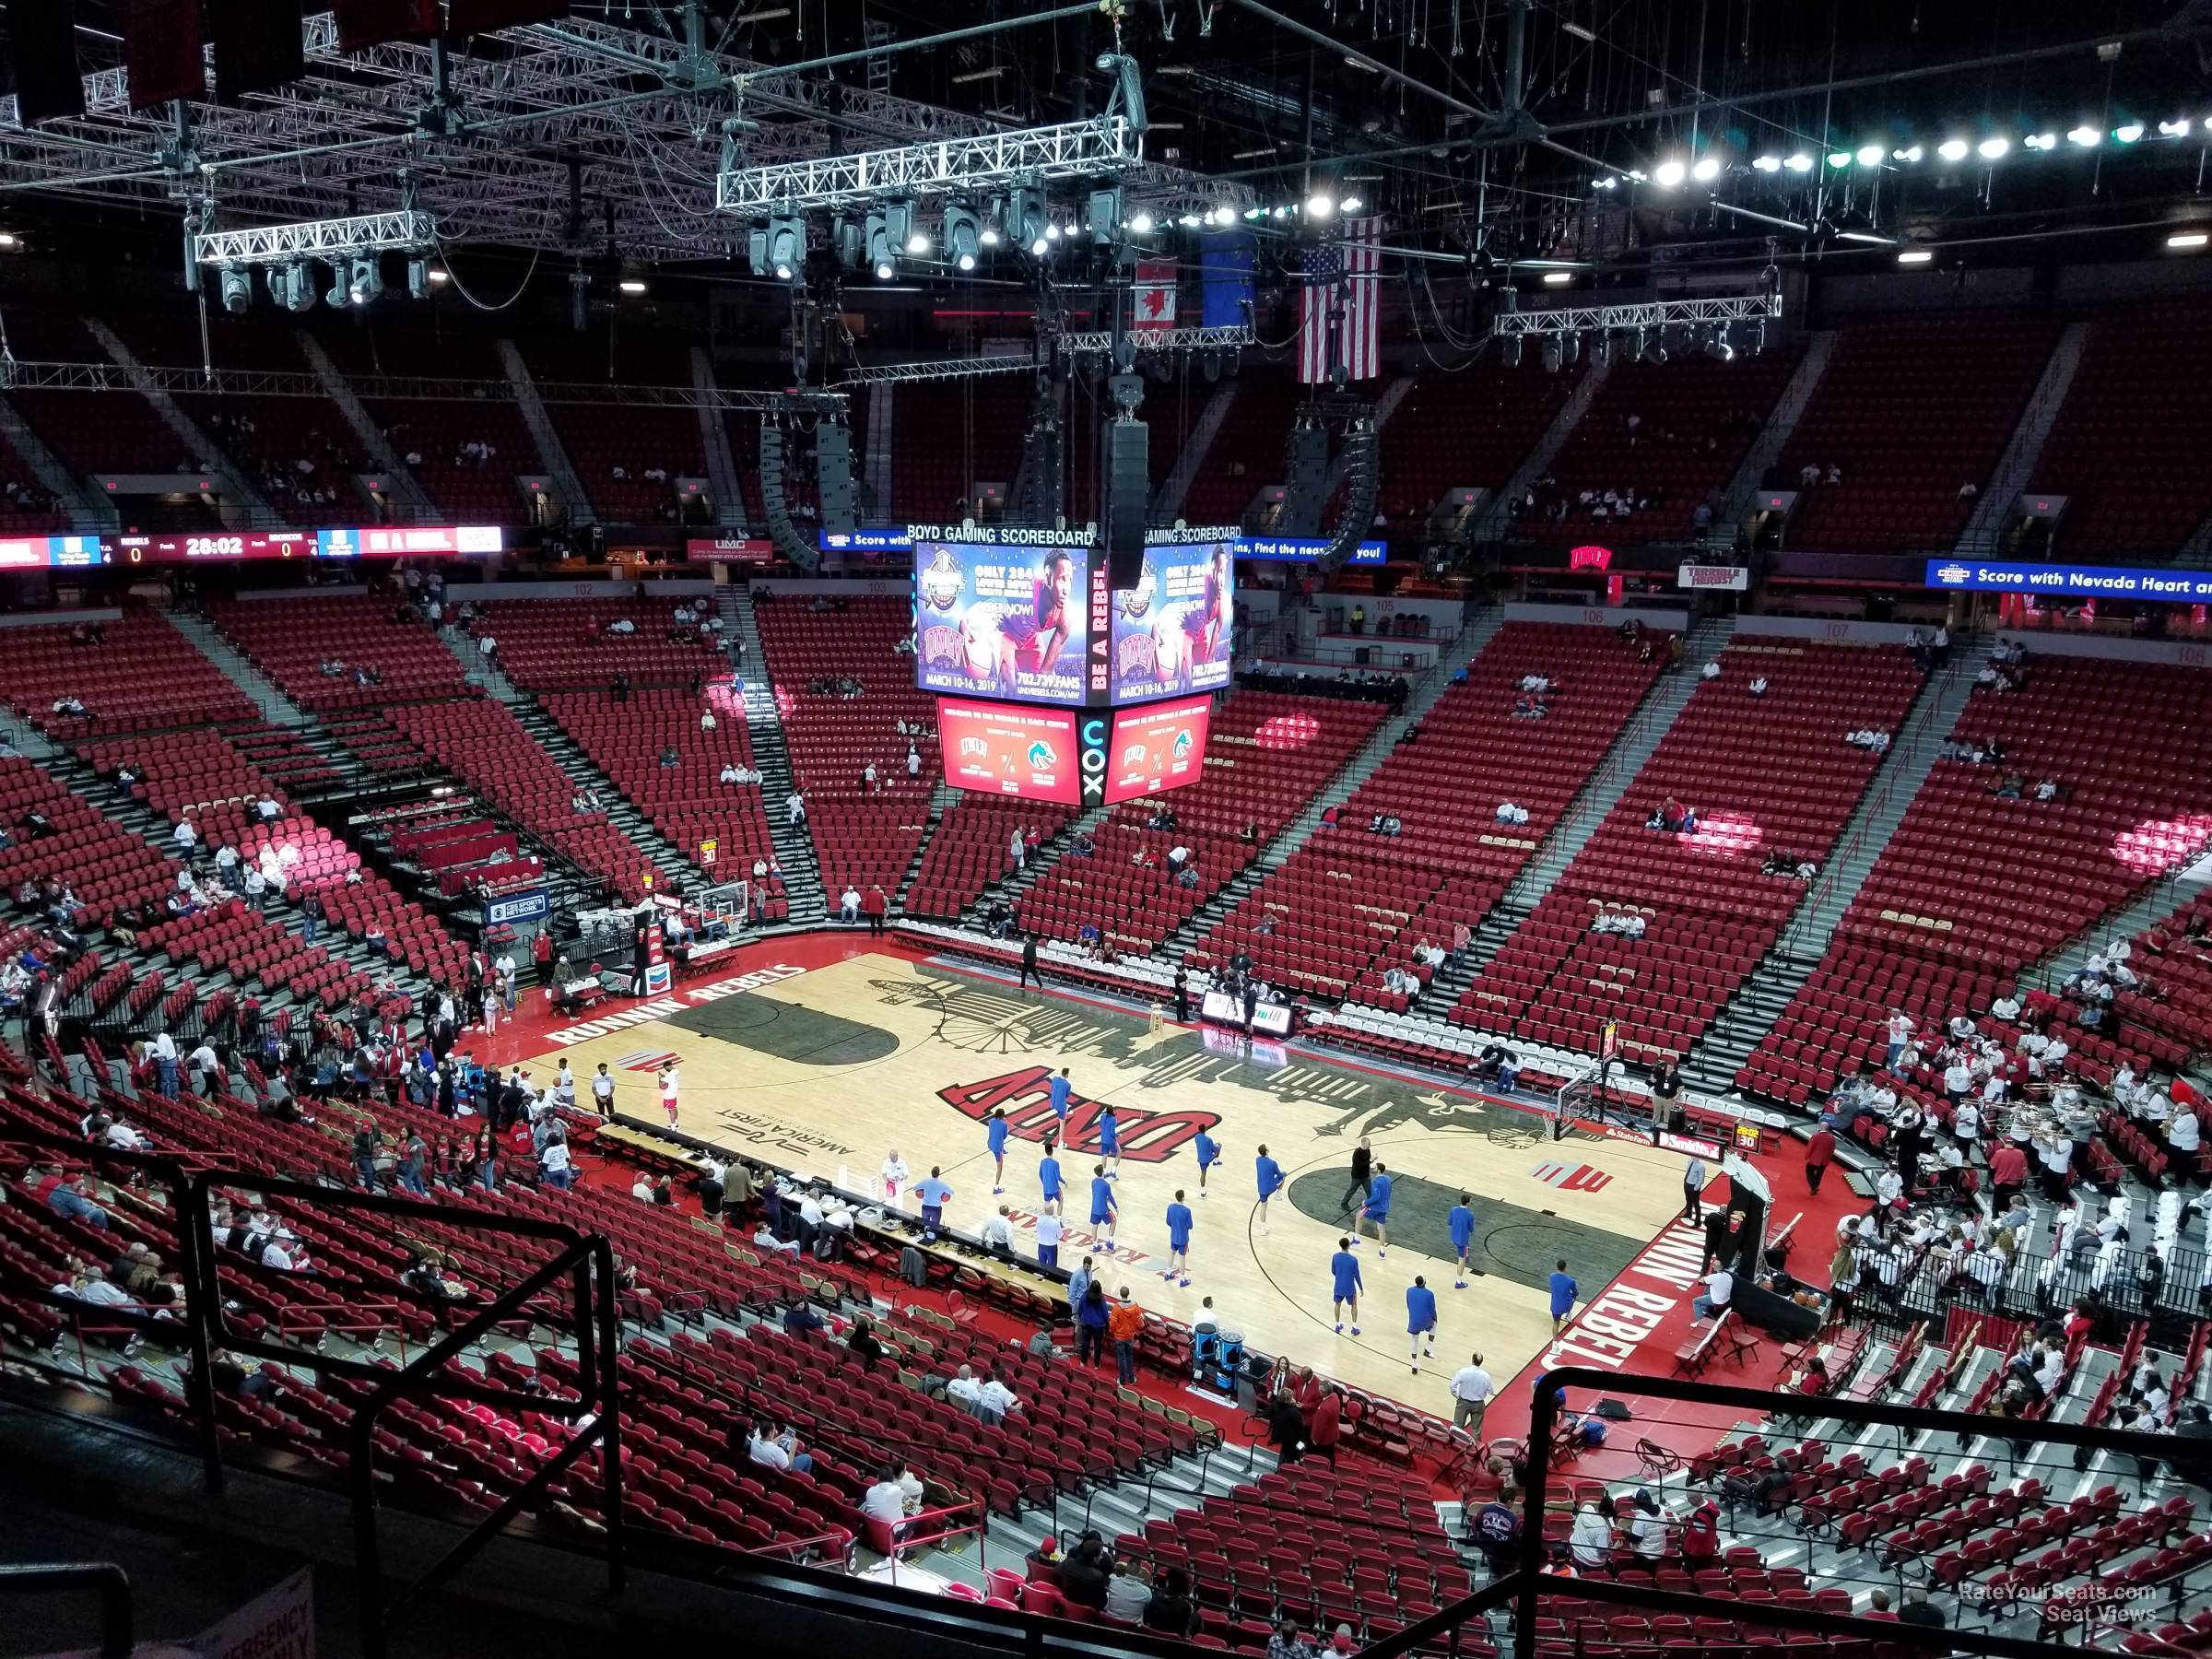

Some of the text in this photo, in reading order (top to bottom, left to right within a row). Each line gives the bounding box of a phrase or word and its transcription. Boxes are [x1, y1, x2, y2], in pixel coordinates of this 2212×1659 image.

[121, 537, 149, 547] REBELS
[855, 535, 886, 546] Score
[888, 534, 912, 546] with
[907, 524, 1094, 546] BOYD GAMING SCOREBOARD
[1182, 526, 1241, 542] SCOREBOARD
[186, 537, 243, 555] 28:02
[281, 543, 290, 557] 0
[715, 539, 746, 549] UMC
[1254, 542, 1276, 554] Find
[1279, 543, 1296, 555] the
[1357, 547, 1381, 559] you!
[131, 548, 141, 562] 0
[574, 583, 594, 596] 102
[1978, 569, 2024, 584] Score
[2030, 571, 2064, 586] with
[2070, 573, 2136, 590] Nevada
[2141, 576, 2190, 594] Heart
[1375, 600, 1394, 613] 105
[1583, 610, 1604, 623] 106
[1825, 623, 1849, 638] 107
[1092, 641, 1108, 658] A
[926, 673, 996, 692] MARCH 10-16, 2019
[1092, 662, 1108, 689] BE
[1119, 683, 1144, 699] MARCH
[1082, 720, 1106, 795] COX
[703, 850, 716, 865] 30
[506, 898, 542, 912] CBS SPORTS
[506, 904, 537, 916] NETWORK
[686, 964, 808, 1002] REBELS
[543, 996, 692, 1046] RUNNIN'
[935, 1065, 1223, 1163] UNLV
[714, 1108, 856, 1156] AMERICA FIRST
[1739, 1136, 1755, 1147] 30
